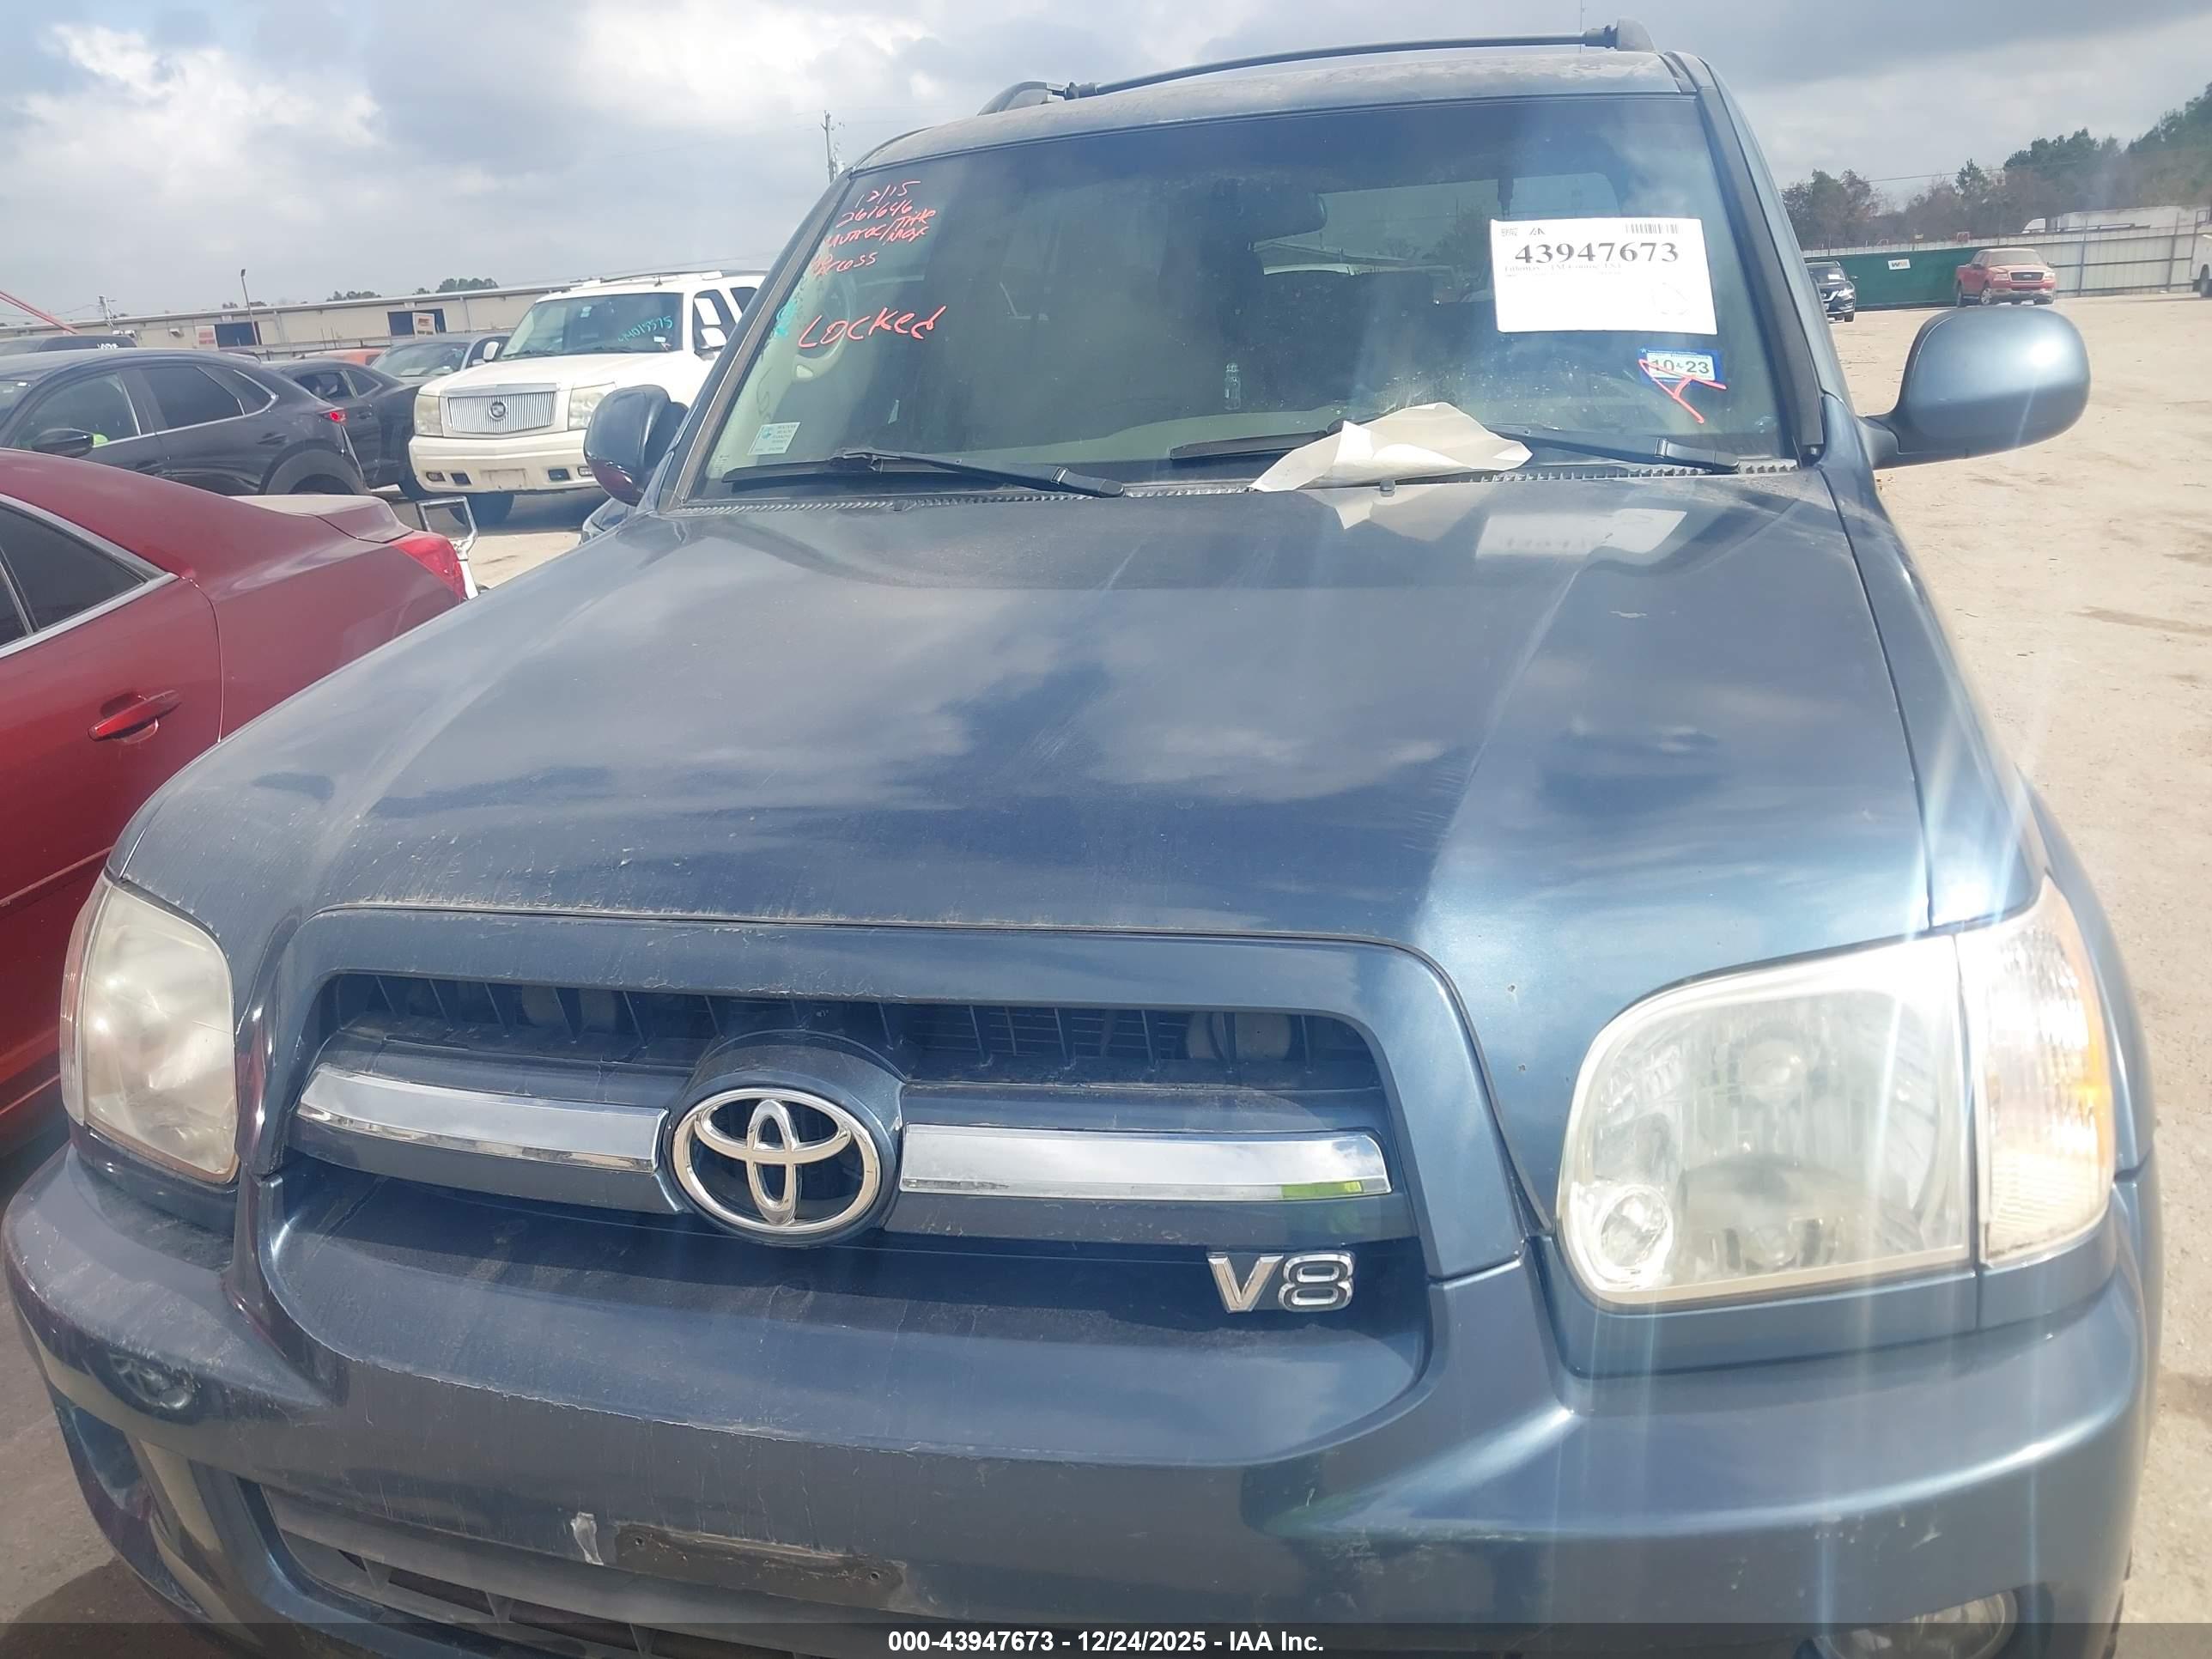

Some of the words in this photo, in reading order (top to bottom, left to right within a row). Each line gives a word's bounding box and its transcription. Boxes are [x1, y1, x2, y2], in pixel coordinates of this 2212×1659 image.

[854, 179, 921, 209] 12/15
[1514, 241, 1680, 264] 43947673
[1207, 1251, 1354, 1313] V8
